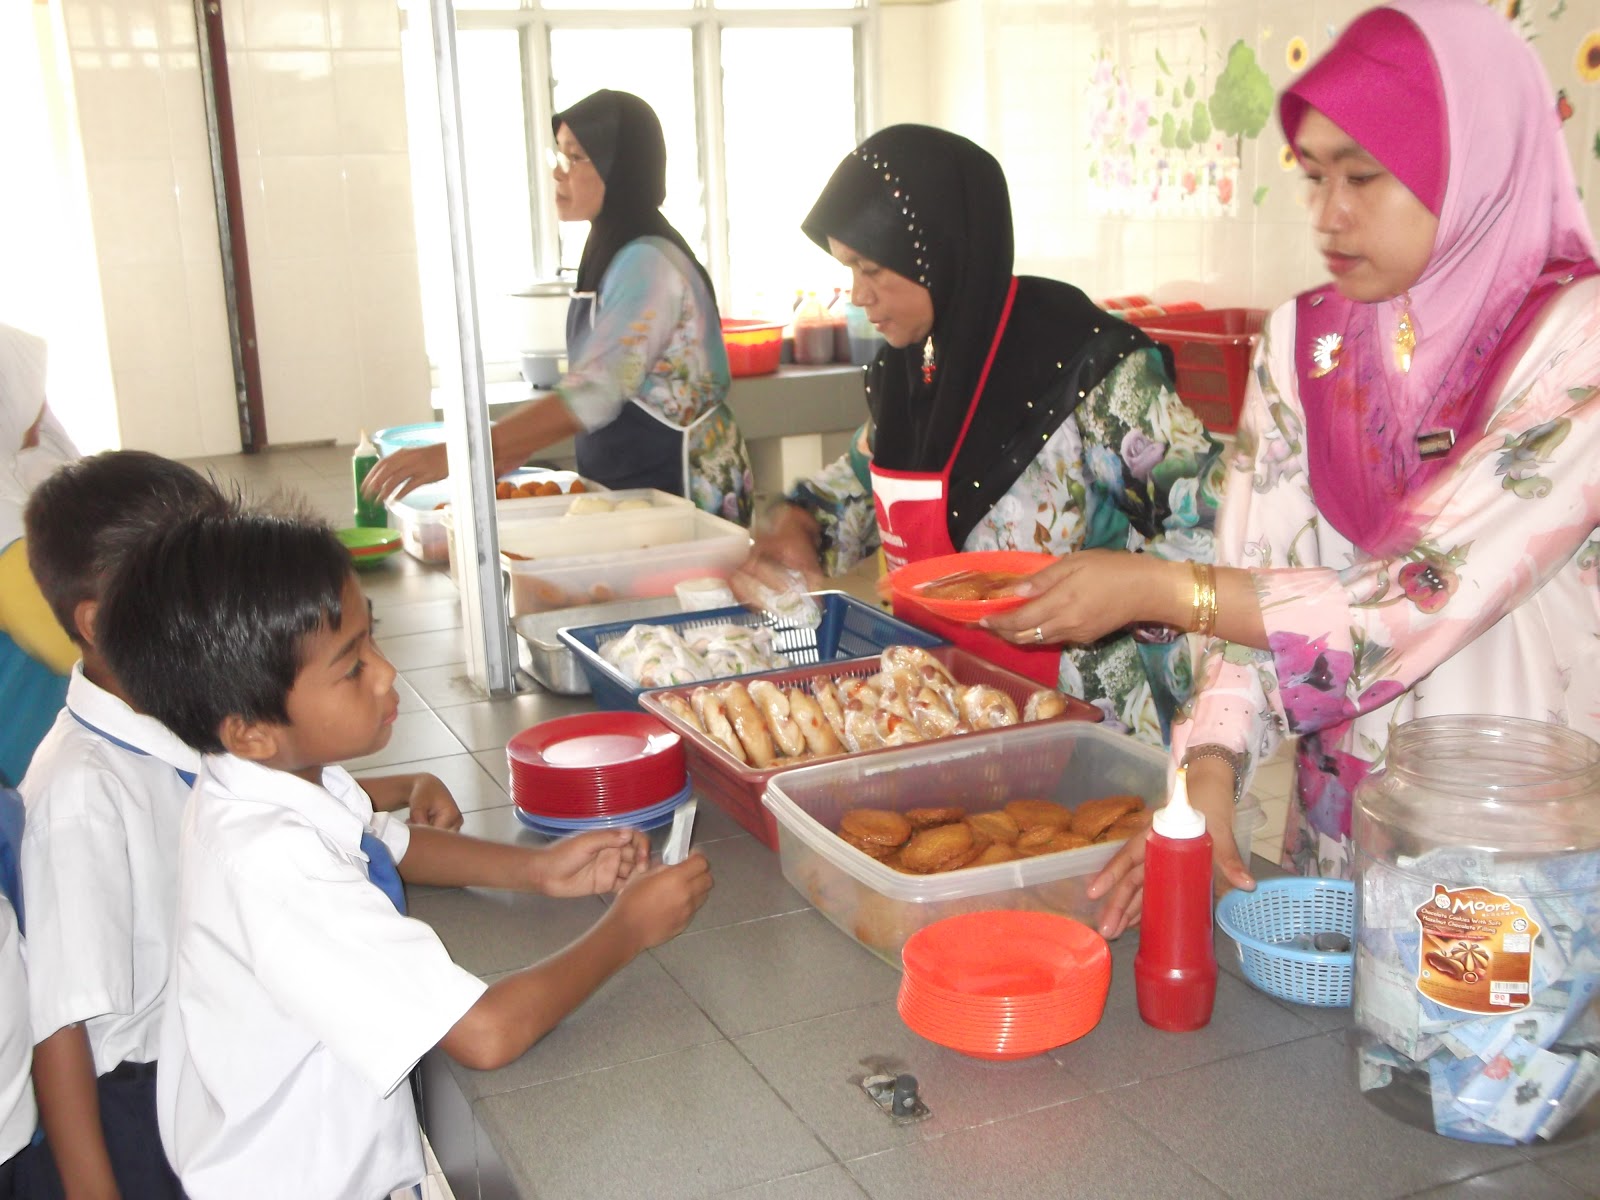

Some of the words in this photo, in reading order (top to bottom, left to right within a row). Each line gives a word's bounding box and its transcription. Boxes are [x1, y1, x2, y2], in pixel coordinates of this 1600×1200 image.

[1452, 898, 1511, 914] Moore
[1421, 908, 1448, 919] Chocolate
[1448, 914, 1471, 923] Cookies
[1422, 915, 1447, 925] Hazelnut
[1448, 921, 1476, 931] Chocolate
[1477, 925, 1497, 935] Filling
